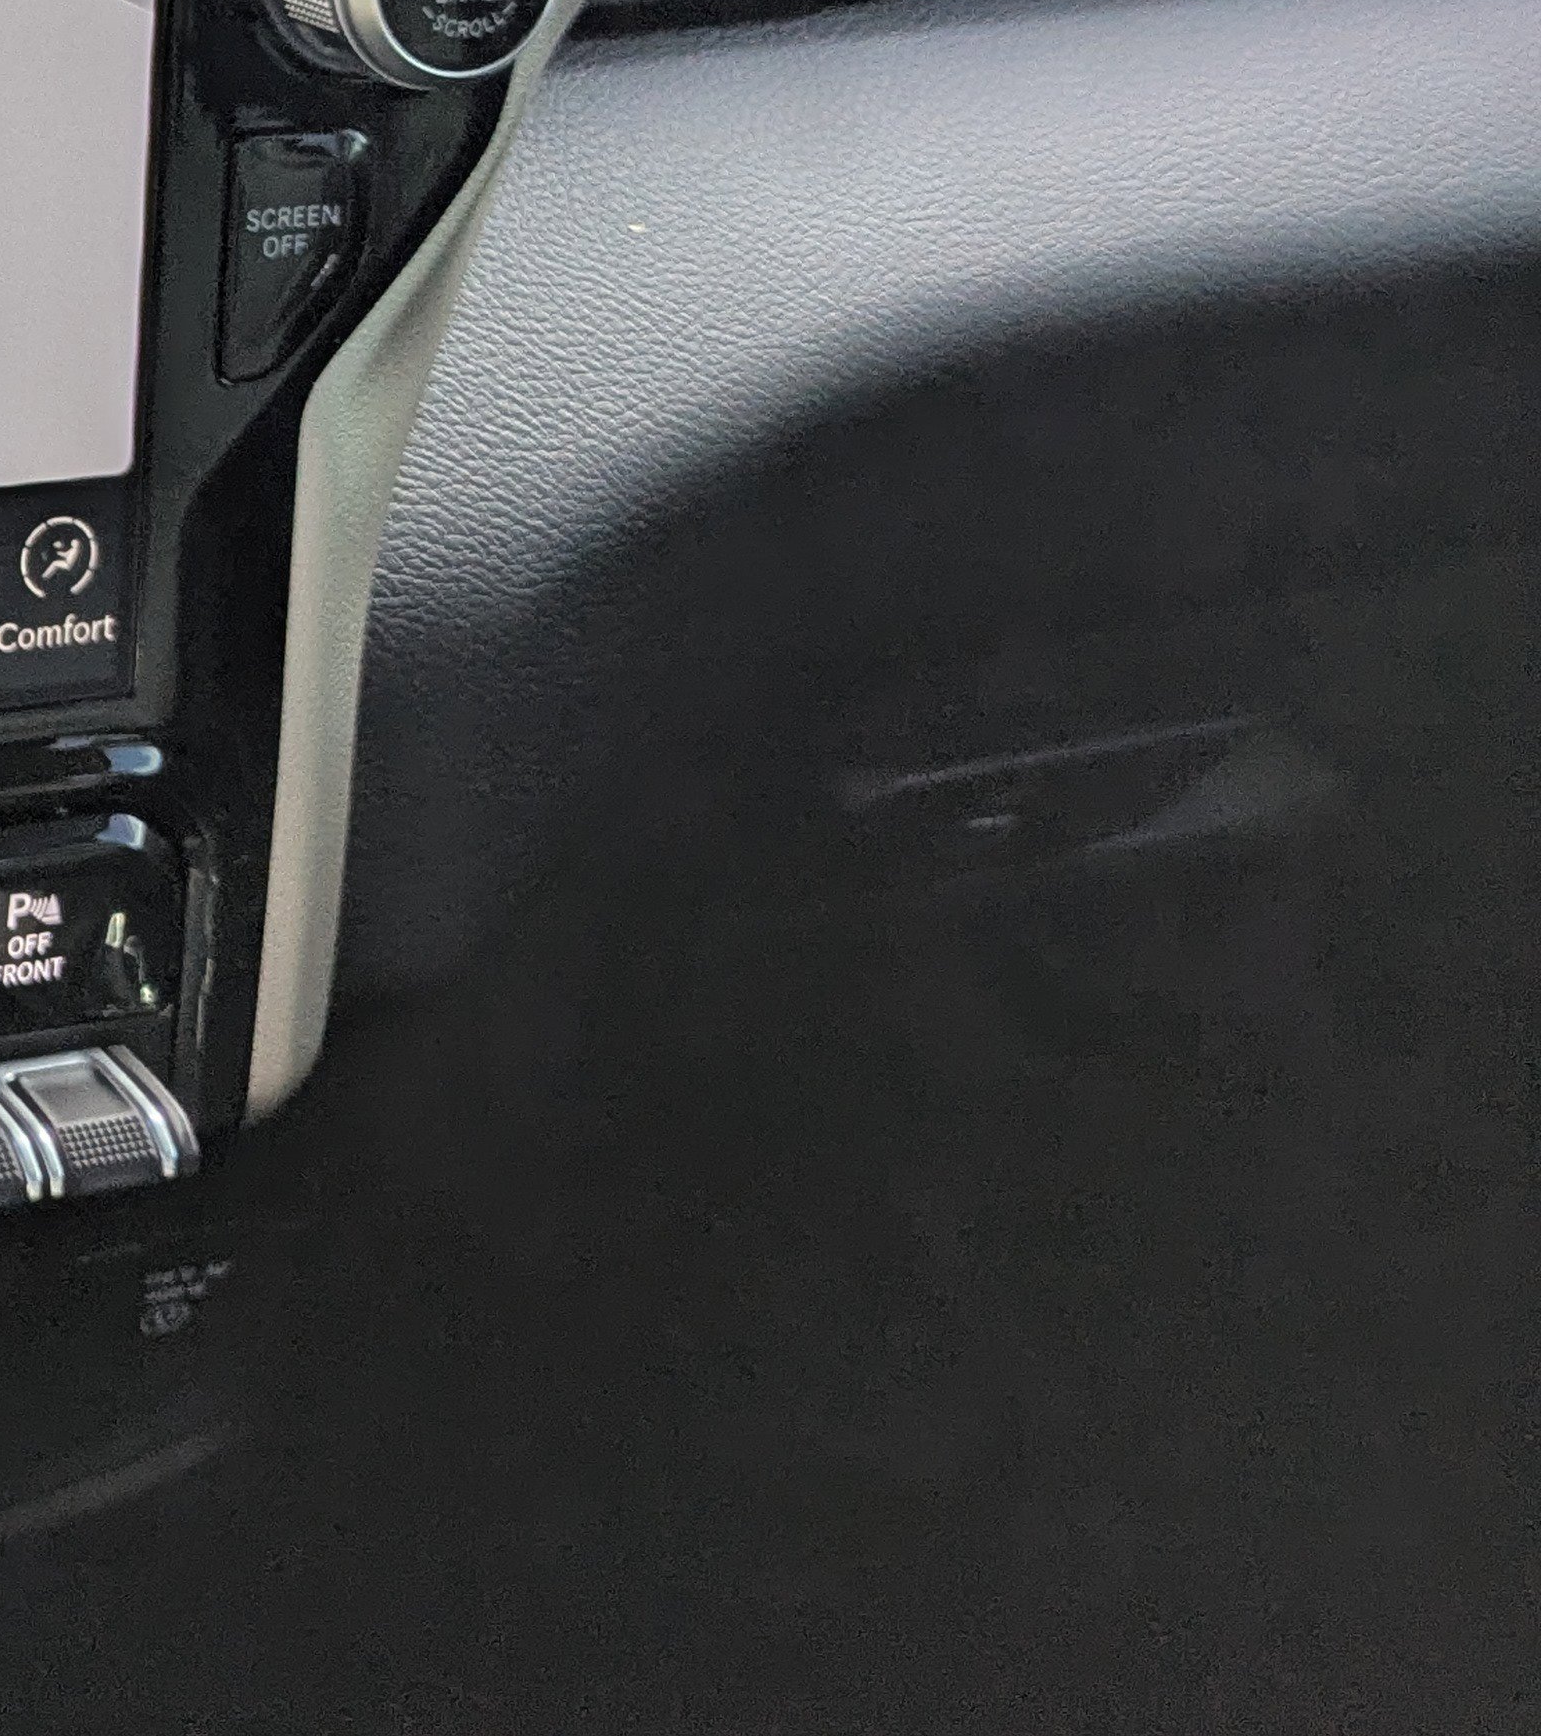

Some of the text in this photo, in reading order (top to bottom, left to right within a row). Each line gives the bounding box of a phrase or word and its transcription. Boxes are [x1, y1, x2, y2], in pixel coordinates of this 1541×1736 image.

[245, 204, 341, 233] SCREEN
[262, 232, 309, 258] OFF
[7, 932, 51, 960] OFF
